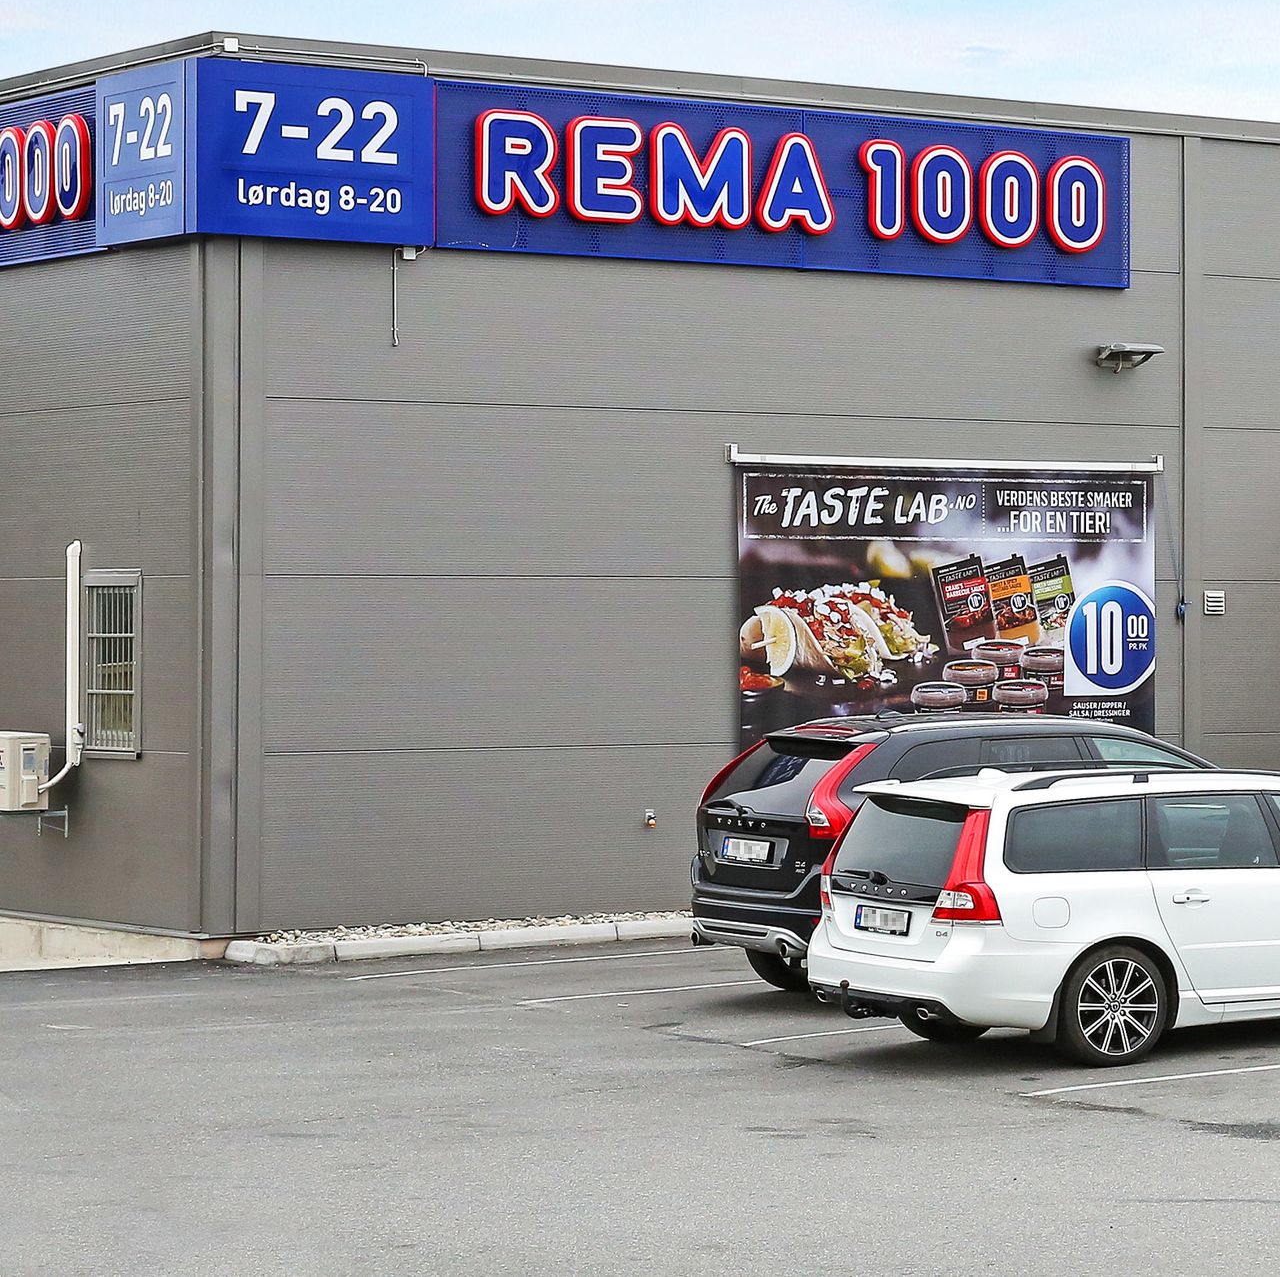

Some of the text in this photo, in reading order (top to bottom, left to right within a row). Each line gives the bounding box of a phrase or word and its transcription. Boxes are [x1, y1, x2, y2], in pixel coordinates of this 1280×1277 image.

[108, 92, 173, 167] 7-22
[234, 90, 399, 165] 7-22
[109, 179, 173, 216] lørdag 8-20
[237, 178, 402, 215] lørdag 8-20
[475, 108, 1105, 254] REMA 1000
[753, 496, 778, 516] The
[780, 486, 890, 528] TASTE
[996, 489, 1133, 509] VERDENS BESTE SMAKER
[997, 510, 1111, 534] ...FOR EN TIER!
